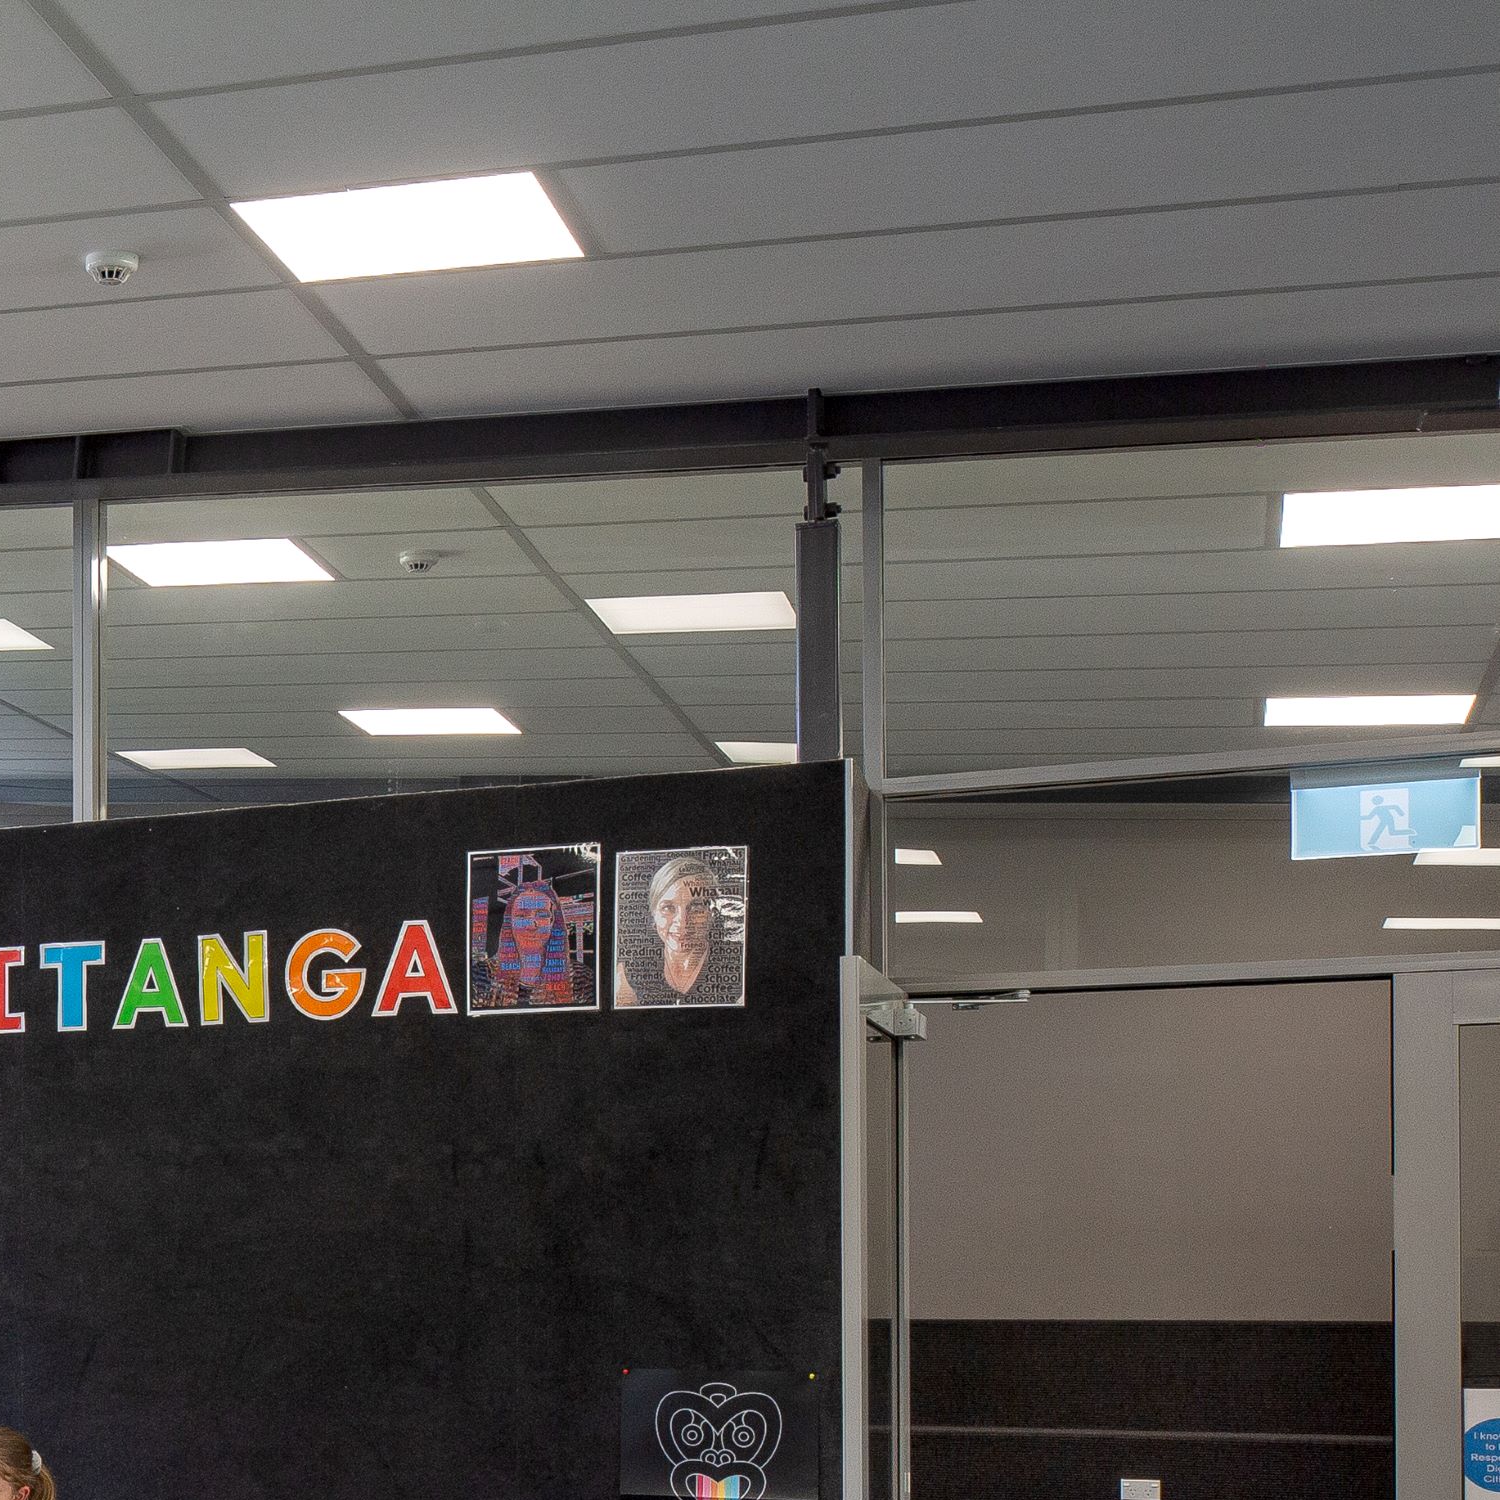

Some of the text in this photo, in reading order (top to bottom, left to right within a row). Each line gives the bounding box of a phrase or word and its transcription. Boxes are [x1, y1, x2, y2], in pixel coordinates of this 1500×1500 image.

[619, 891, 649, 900] Coffee
[689, 887, 740, 898] Whaau
[618, 948, 662, 958] Reading
[708, 964, 741, 973] Coffee
[705, 974, 741, 984] School
[697, 984, 733, 993] Coffee
[1480, 1432, 1500, 1440] kno
